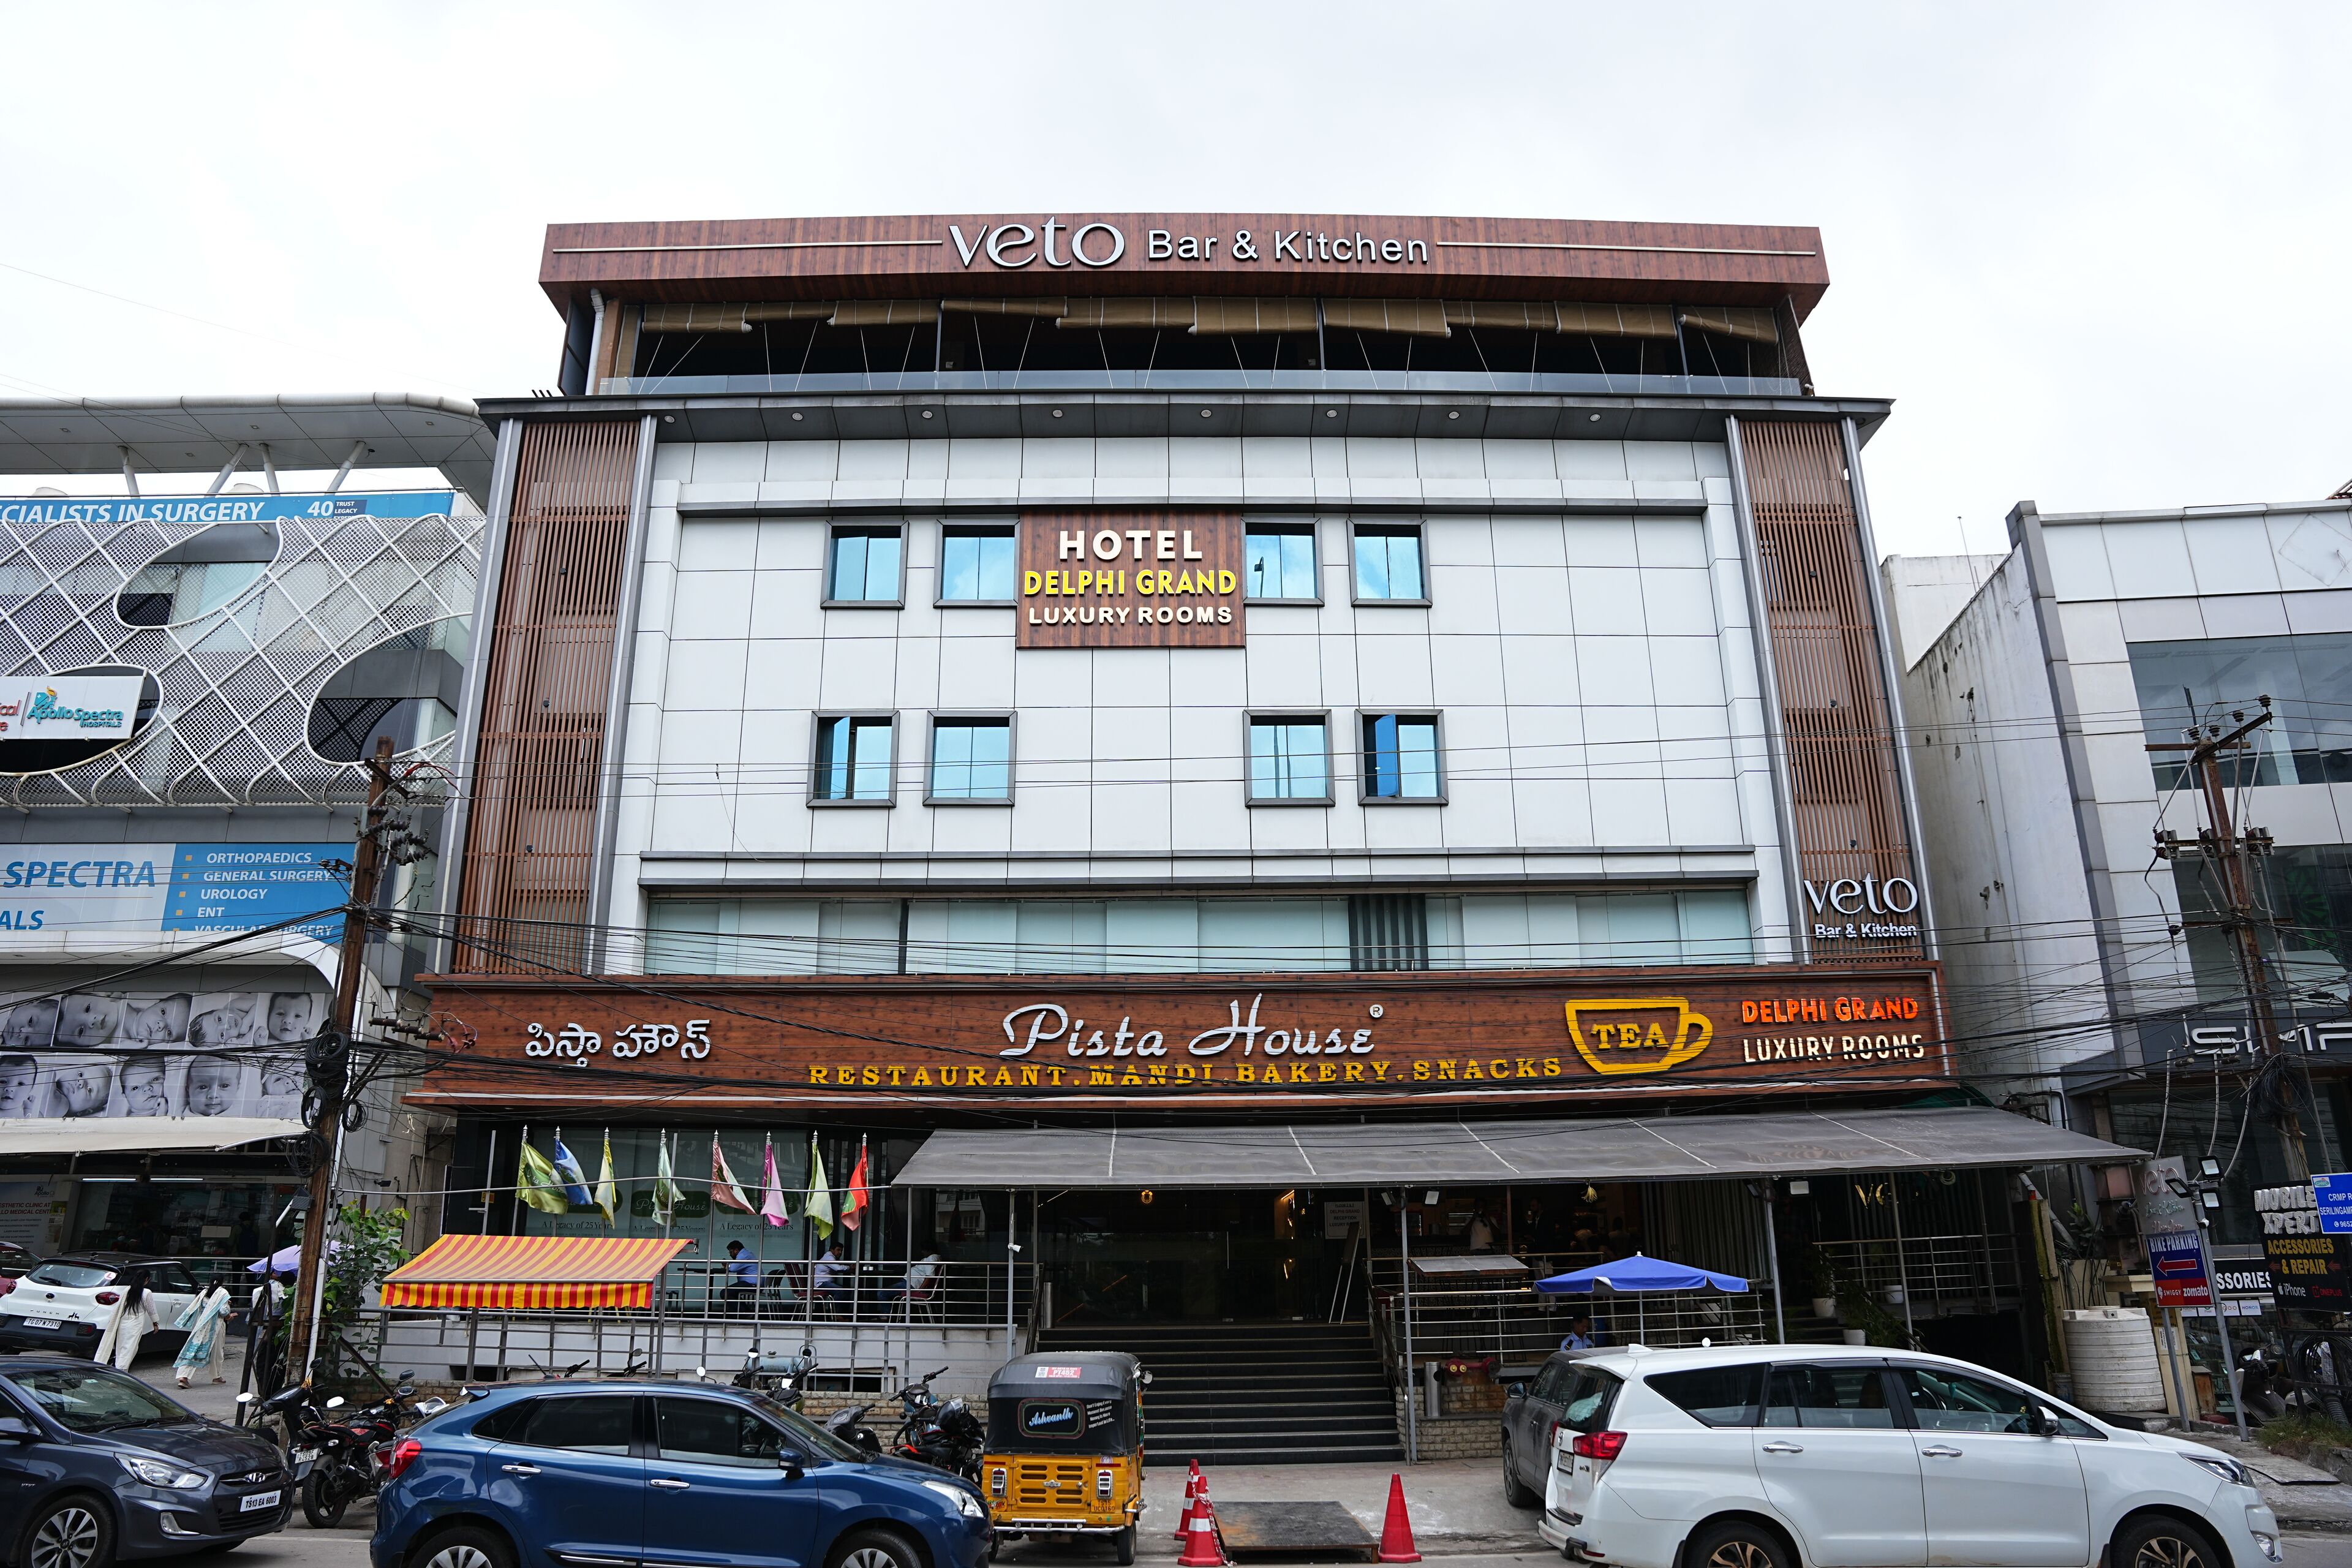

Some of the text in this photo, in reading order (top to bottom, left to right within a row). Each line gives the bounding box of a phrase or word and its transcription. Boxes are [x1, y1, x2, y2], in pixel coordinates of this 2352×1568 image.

[948, 216, 1429, 269] veto Bar & Kitchen
[0, 502, 265, 523] CIALISTS IN SURGERY
[307, 500, 334, 516] 40
[1059, 529, 1203, 560] HOTEL
[1023, 568, 1237, 595] DELPHI GRAND
[1028, 606, 1233, 624] LUXURY ROOMS
[0, 700, 21, 716] cal
[26, 706, 124, 728] Apollo Spectra
[206, 853, 312, 863] ORTHOPAEDICS
[2, 861, 155, 888] SPECTRA
[203, 870, 333, 881] GENERAL SURGERY
[200, 889, 268, 899] UROLOGY
[1803, 872, 1918, 914] veto
[197, 907, 225, 918] ENT
[1814, 922, 1918, 938] Bar & Kitchen
[1742, 996, 1919, 1024] DELPHI GRAND
[999, 1002, 1167, 1057] Pista
[1188, 992, 1376, 1057] House
[1591, 1022, 1671, 1050] TEA
[1743, 1033, 1926, 1063] LUXURY ROOMS
[2254, 1185, 2316, 1212] MOBILE
[549, 1221, 574, 1230] Lgacy
[2261, 1210, 2320, 1235] XPERT
[2149, 1233, 2199, 1253] BIKE PARKING
[2267, 1238, 2334, 1255] ACCESSORIES
[2281, 1259, 2328, 1275] & REPAIR
[2182, 1284, 2209, 1297] zomato
[2283, 1283, 2343, 1297] iPhone ONEPLUS
[246, 1495, 277, 1509] TS13 EA 6003
